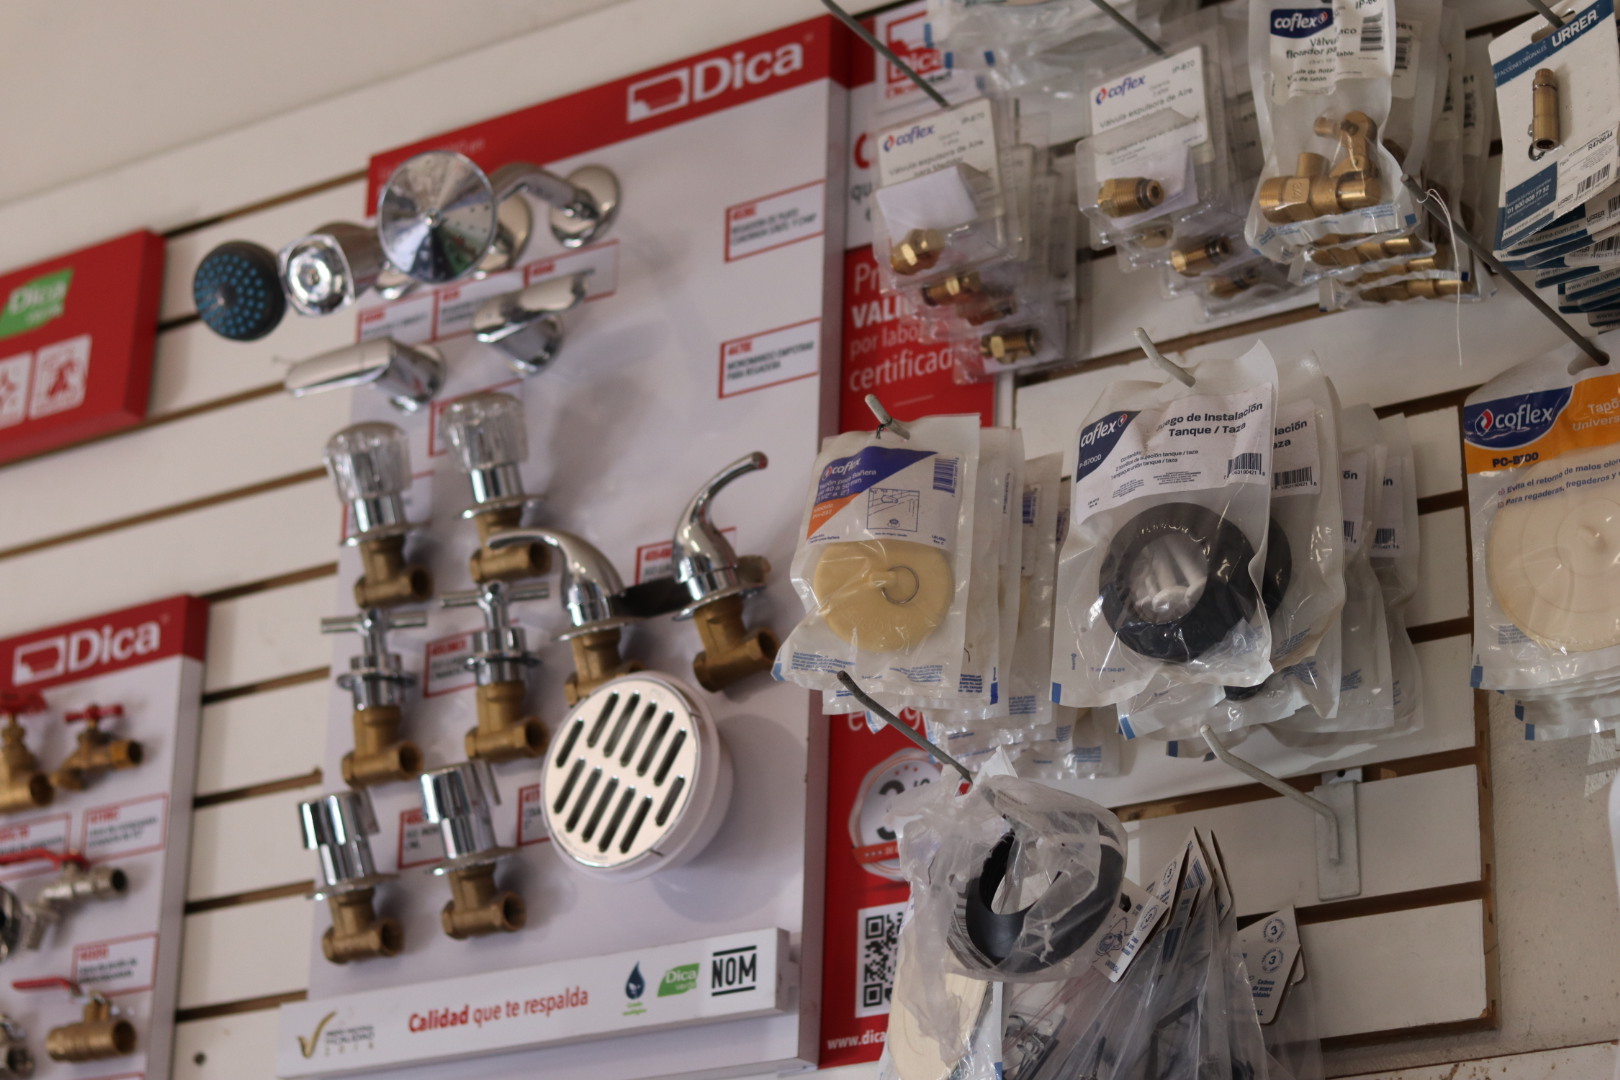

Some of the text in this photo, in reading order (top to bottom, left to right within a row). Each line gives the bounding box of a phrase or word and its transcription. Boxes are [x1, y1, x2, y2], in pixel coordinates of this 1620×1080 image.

[1274, 13, 1318, 32] coflex
[1551, 9, 1598, 48] URREA
[693, 43, 804, 103] Dica
[1108, 75, 1147, 98] coflex
[1166, 94, 1176, 103] de
[1178, 87, 1194, 98] Aire
[896, 124, 935, 145] coflex
[957, 144, 967, 153] de
[850, 335, 878, 362] por
[1187, 413, 1201, 422] de
[1204, 402, 1263, 422] Instalación
[1495, 403, 1554, 430] coflex
[1588, 397, 1620, 415] Tapó
[1081, 420, 1117, 448] coflex
[1168, 421, 1246, 437] Tanque / Taza
[1572, 416, 1620, 431] Univers
[832, 457, 862, 475] coflex
[1507, 483, 1525, 494] Evita
[1564, 466, 1574, 476] de
[1575, 463, 1602, 473] malos
[1506, 494, 1523, 506] Para
[1566, 474, 1610, 489] fregaderos
[68, 621, 161, 672] Dica
[1271, 925, 1278, 936] 3
[1269, 955, 1277, 965] 3
[666, 969, 697, 984] Dica
[712, 953, 757, 989] NOM
[409, 985, 589, 1033] Calidad que te respalda
